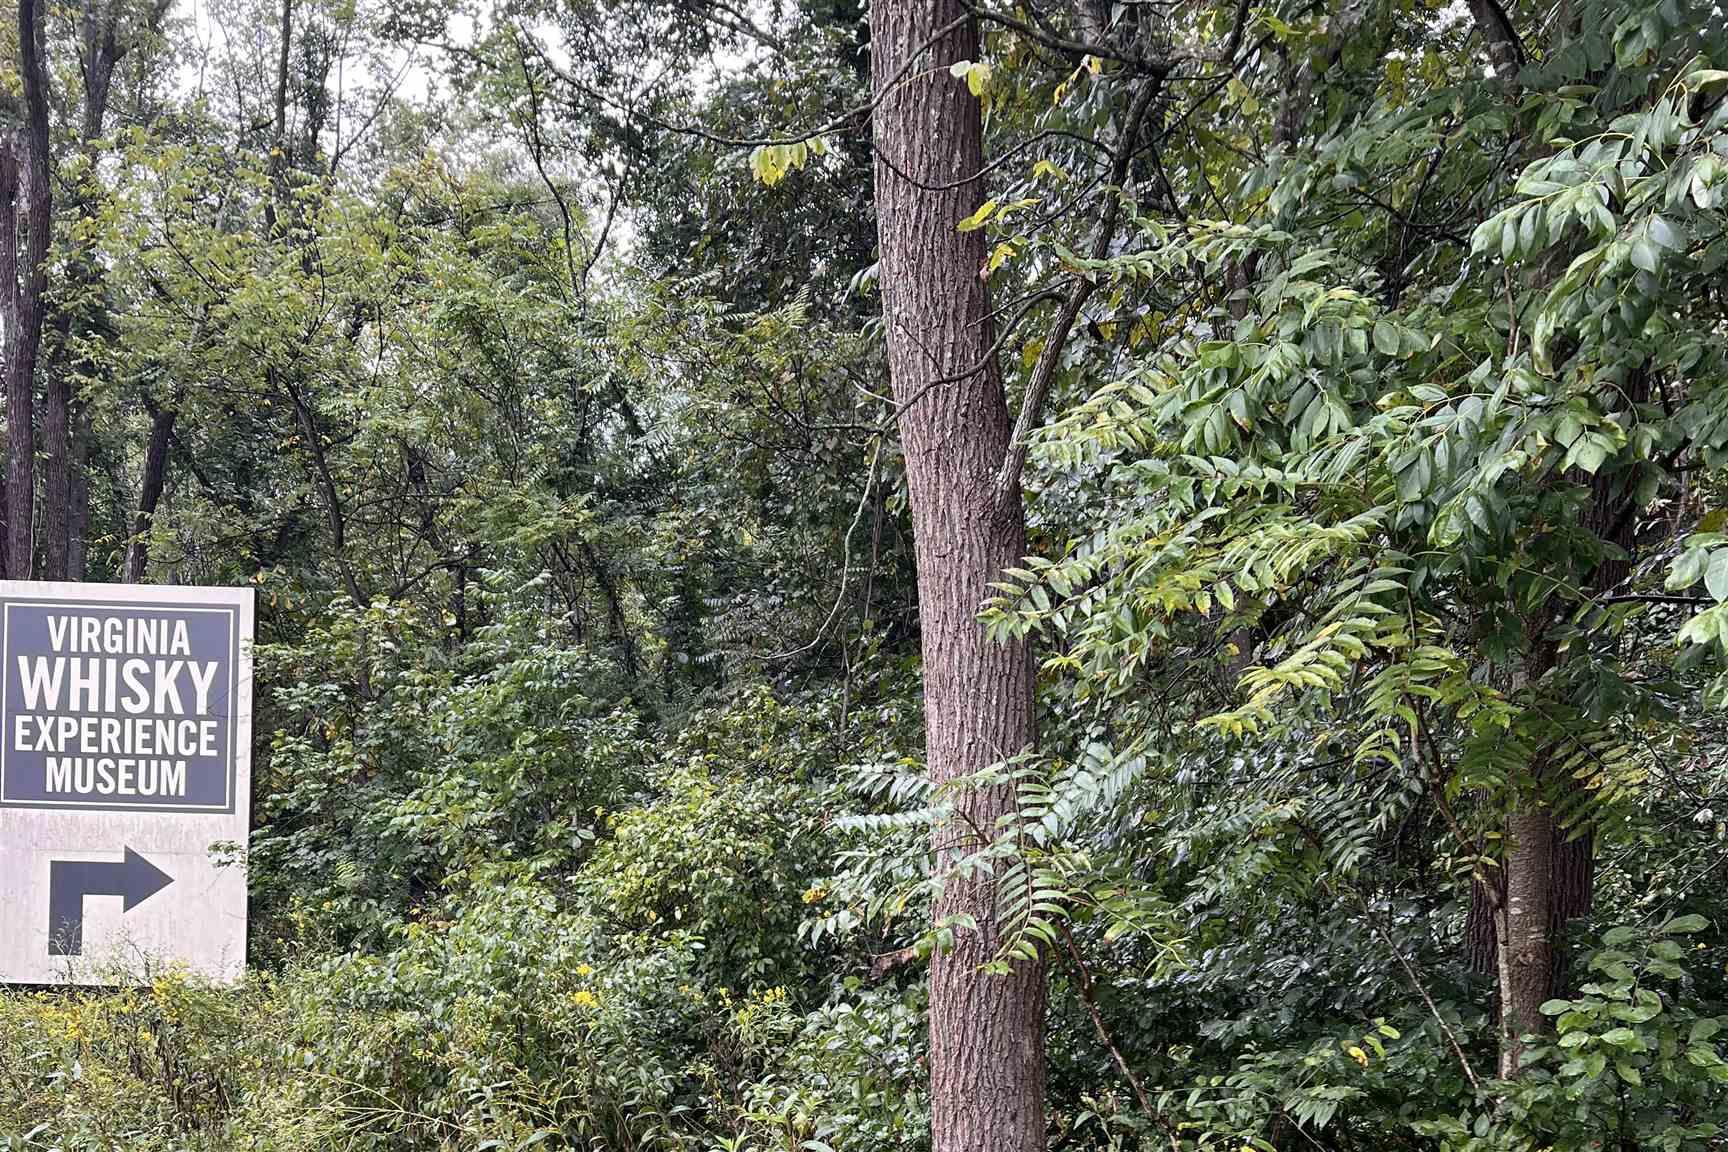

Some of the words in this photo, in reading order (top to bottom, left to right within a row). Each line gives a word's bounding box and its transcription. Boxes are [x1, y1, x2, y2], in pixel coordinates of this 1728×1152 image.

[47, 615, 191, 656] VIRGINIA
[17, 655, 219, 716] WHISKY
[14, 715, 218, 757] EXPERIENCE
[45, 757, 186, 797] MUSEUM
